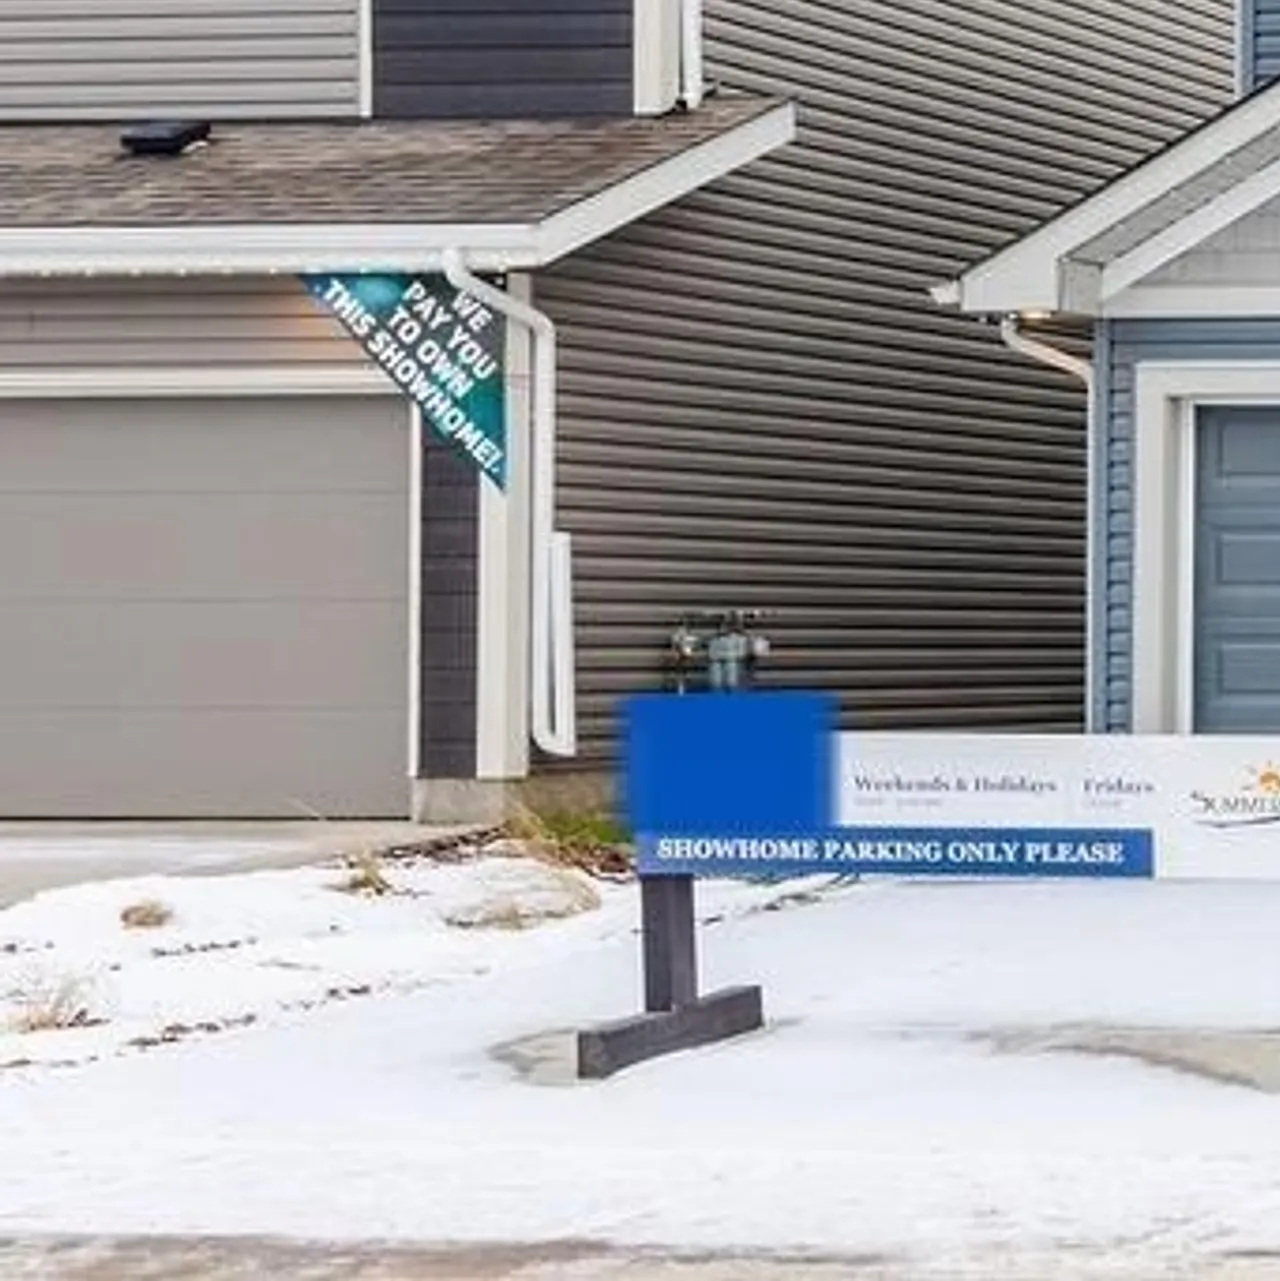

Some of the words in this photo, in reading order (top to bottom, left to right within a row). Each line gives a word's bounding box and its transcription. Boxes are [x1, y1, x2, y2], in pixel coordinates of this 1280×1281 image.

[323, 279, 377, 336] THIS
[451, 289, 492, 332] WE
[402, 281, 452, 330] PAY
[447, 325, 497, 379] YOU
[388, 305, 421, 344] TO
[417, 340, 474, 399] OWN
[854, 774, 950, 792] Weekends
[974, 775, 1058, 795] Holidays
[1083, 776, 1155, 795] Fridays
[657, 837, 819, 861] SHOWHOME
[824, 838, 943, 862] PARKING
[947, 839, 1021, 863] ONLY
[1026, 841, 1124, 864] PLEASE
